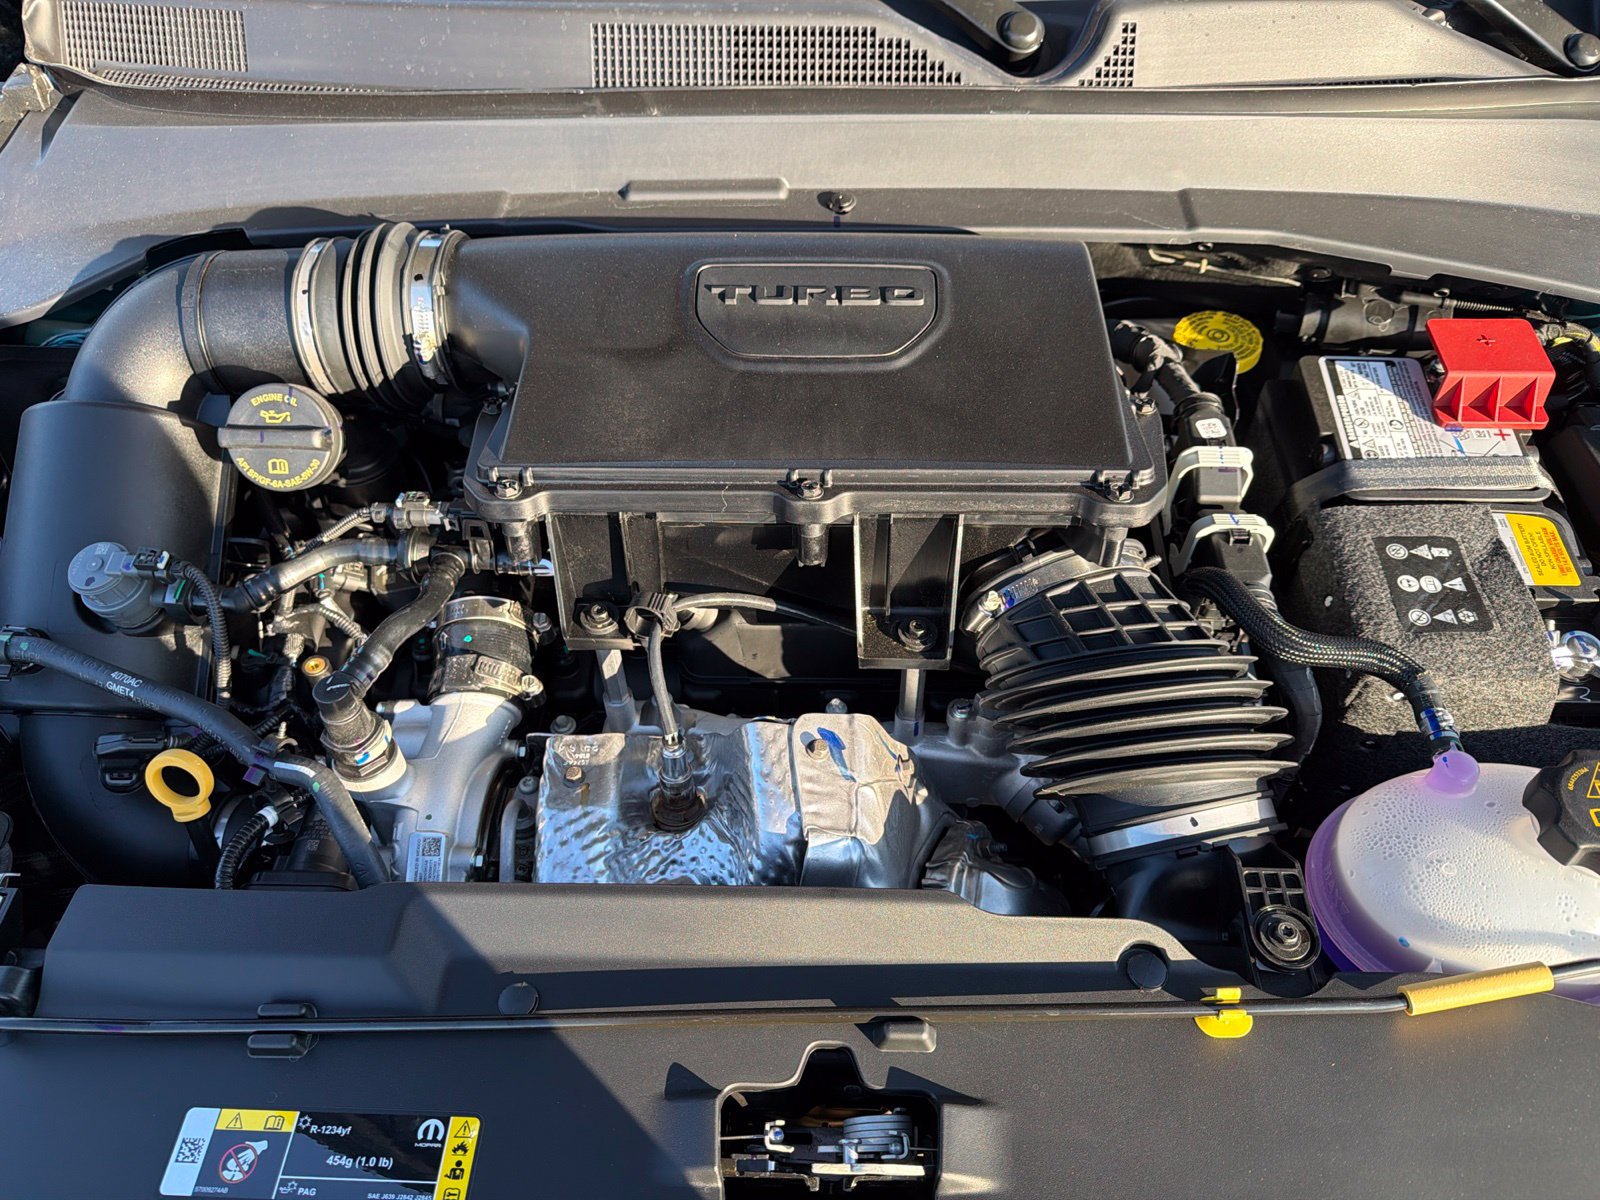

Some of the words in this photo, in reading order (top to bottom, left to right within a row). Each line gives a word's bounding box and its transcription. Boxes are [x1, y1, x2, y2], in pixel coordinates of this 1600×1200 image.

[704, 284, 924, 306] TURBO
[251, 393, 282, 407] ENGINE
[283, 396, 298, 407] OIL
[236, 457, 250, 472] API
[1516, 522, 1530, 545] BATTERY
[1531, 556, 1543, 576] SEALED
[110, 670, 143, 688] 4070AC
[106, 681, 134, 697] GMET4
[309, 1125, 352, 1137] R-1234yf
[326, 1155, 353, 1168] 454g
[355, 1156, 376, 1168] (1.0
[378, 1157, 394, 1170] lb)
[297, 1187, 317, 1196] PAG
